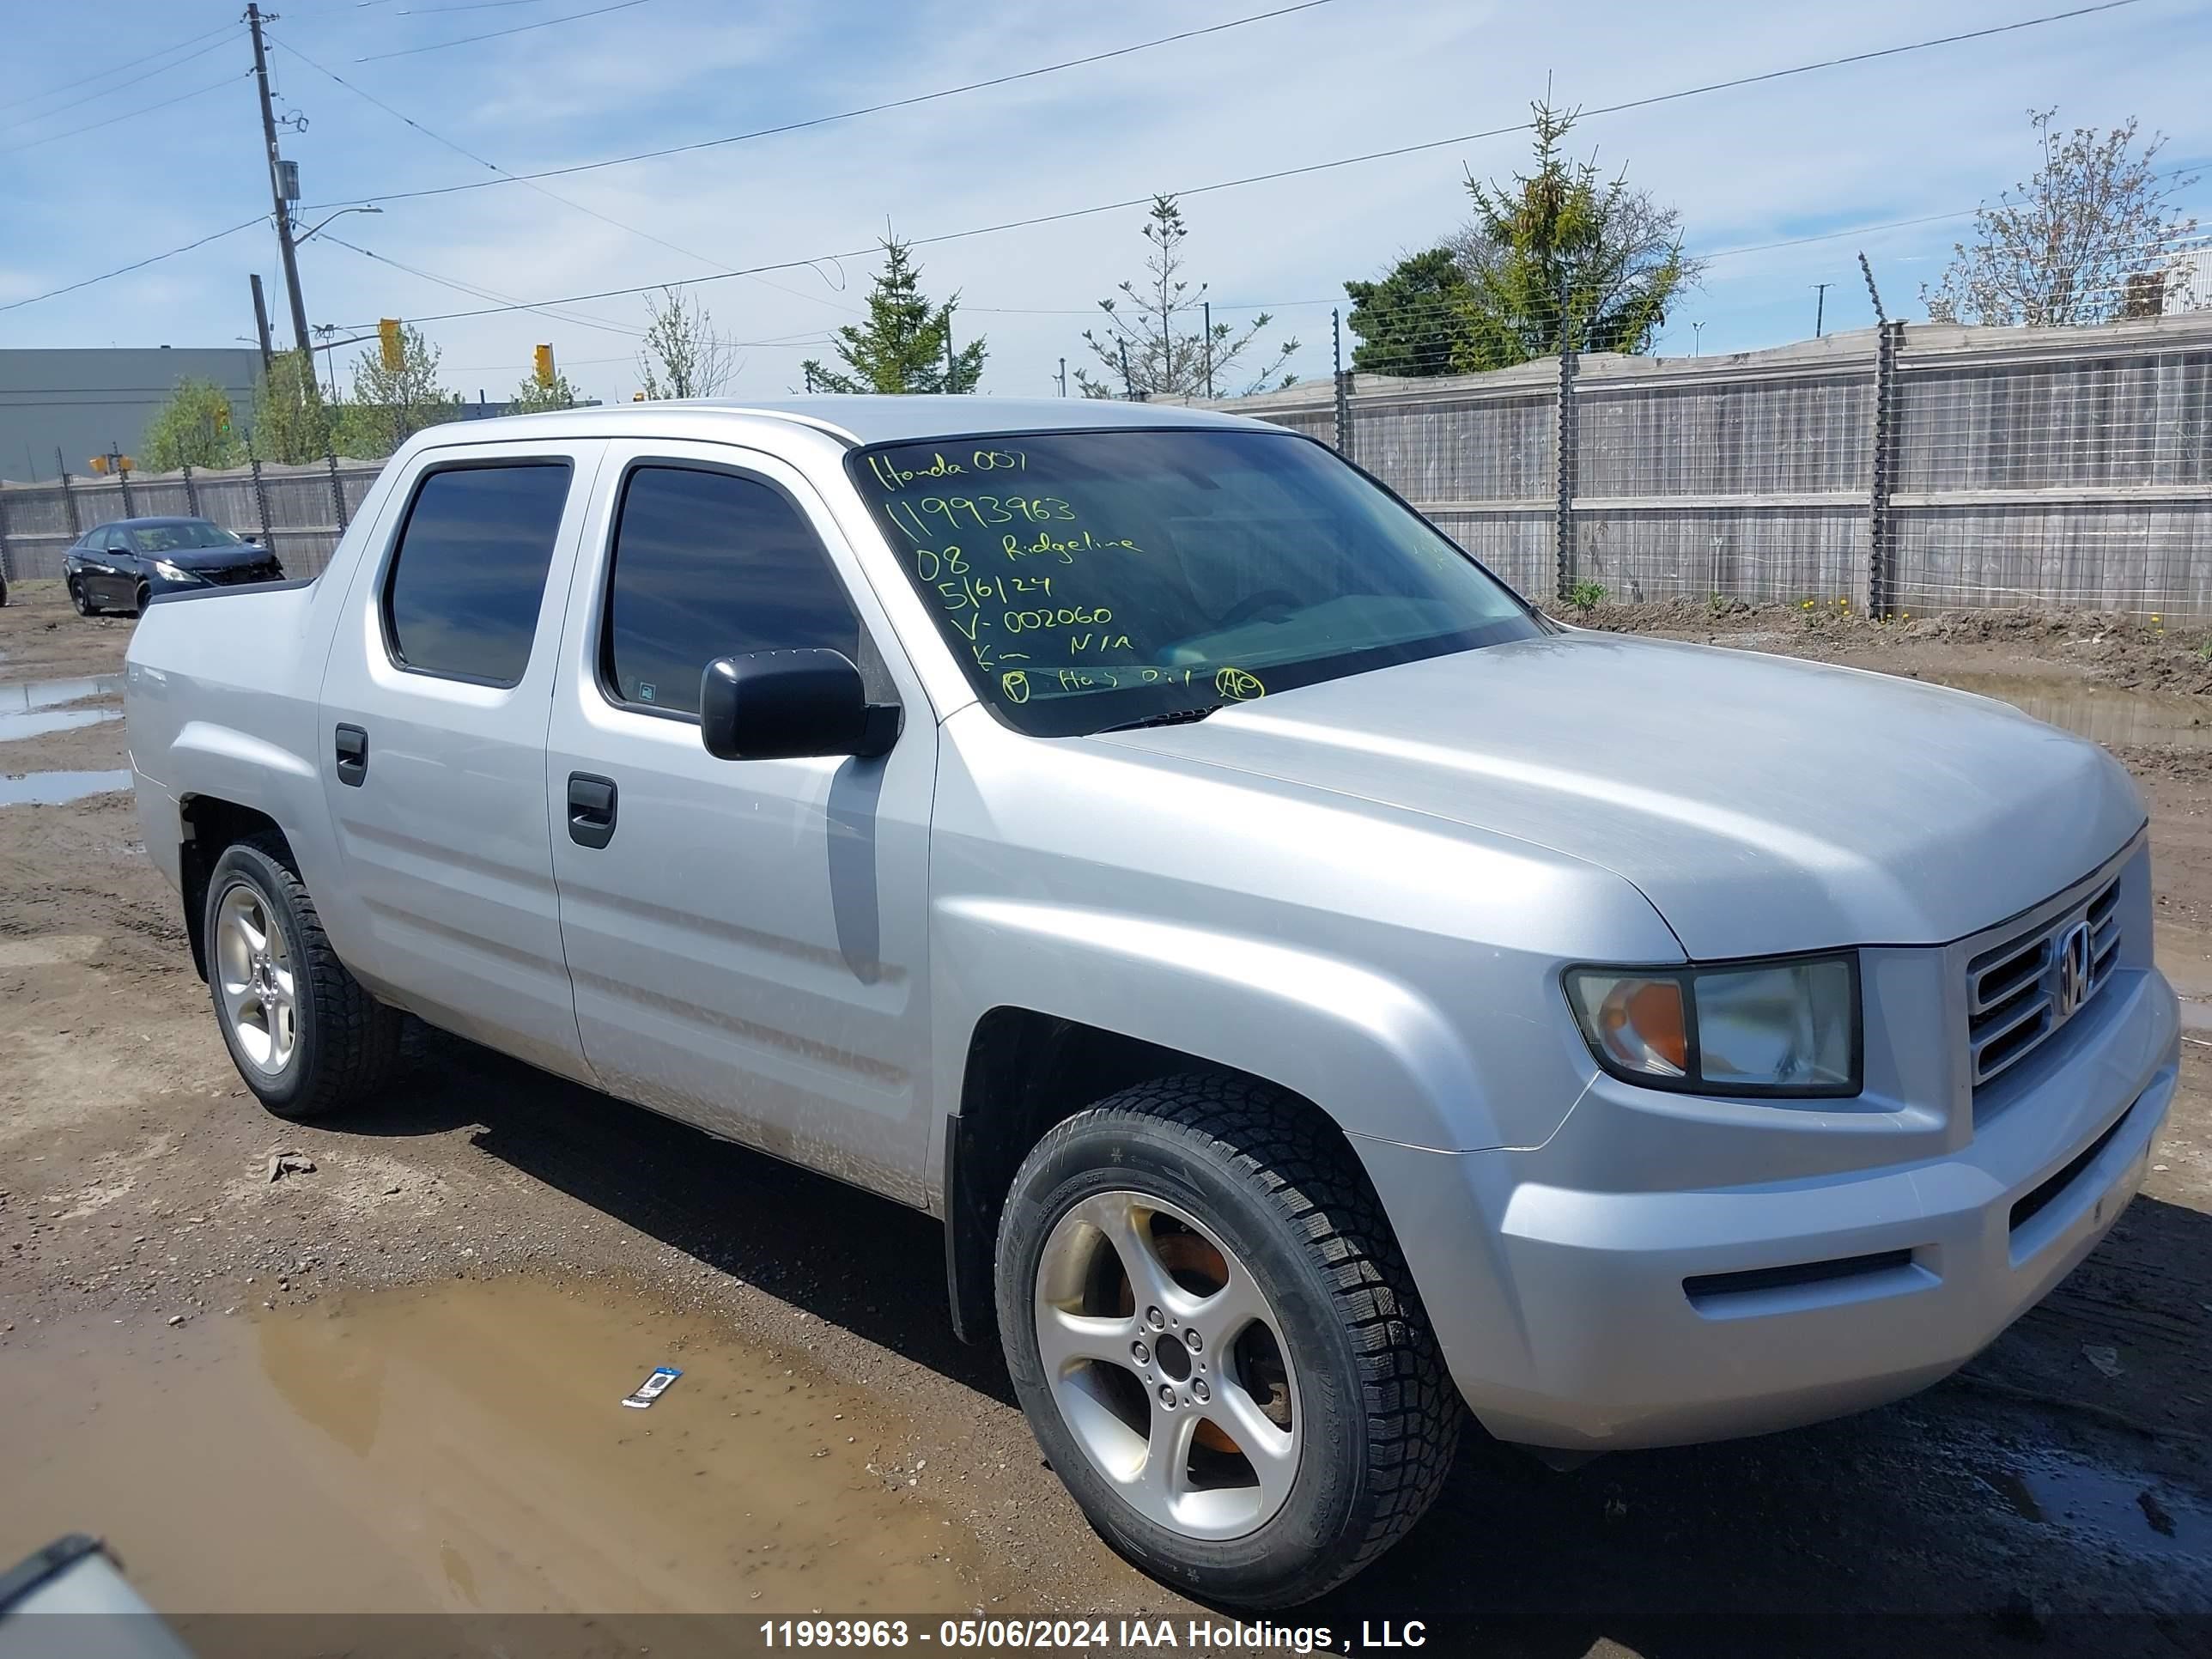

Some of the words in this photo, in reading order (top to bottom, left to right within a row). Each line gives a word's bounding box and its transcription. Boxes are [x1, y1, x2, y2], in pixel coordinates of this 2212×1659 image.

[868, 452, 969, 492] Honda
[885, 495, 1076, 544] 11993963
[916, 545, 970, 581] 08
[1002, 531, 1145, 564] Ridgeline
[938, 575, 1052, 610] 5/6/24
[1004, 606, 1113, 633] 002060
